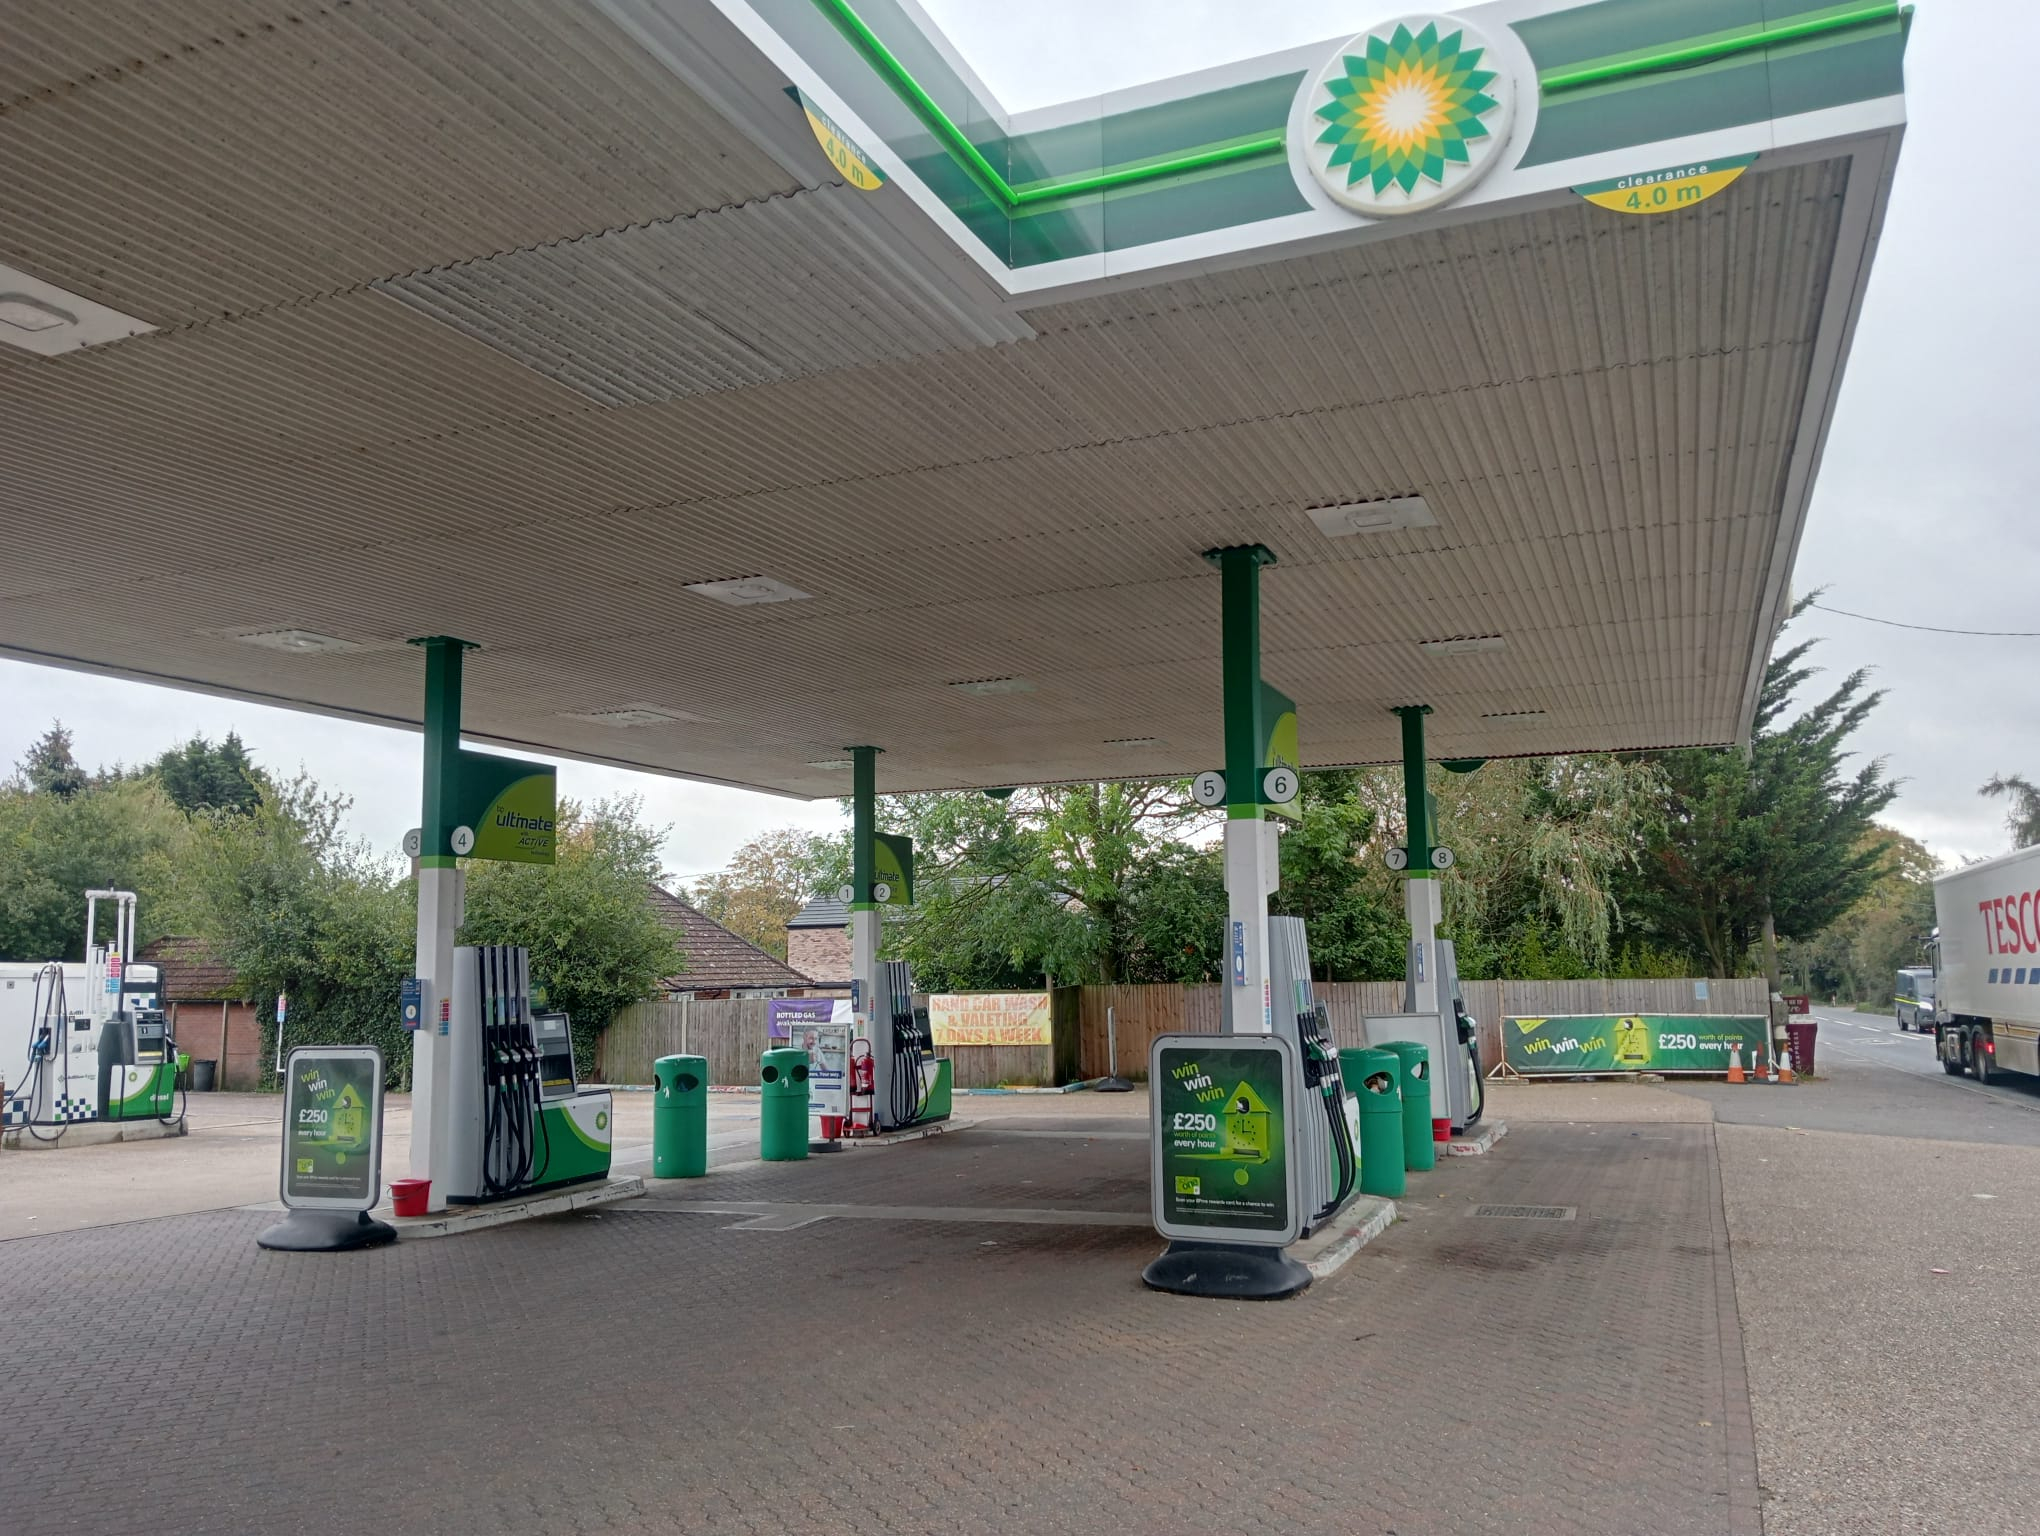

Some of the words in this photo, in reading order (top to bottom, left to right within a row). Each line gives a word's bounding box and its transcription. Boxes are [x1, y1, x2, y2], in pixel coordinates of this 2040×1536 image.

[822, 116, 867, 165] clearance
[826, 138, 847, 169] 4.0
[852, 164, 864, 187] m
[1617, 164, 1709, 189] clearance
[1625, 186, 1668, 210] 4.0
[1676, 183, 1702, 202] m
[1203, 780, 1215, 797] 5
[1275, 776, 1287, 794] 6
[496, 811, 553, 832] ultimate
[410, 835, 418, 850] 3
[458, 833, 467, 847] 4
[518, 837, 550, 847] ACTIVE
[1392, 853, 1400, 864] 7
[1438, 852, 1447, 863] 8
[879, 888, 885, 898] 2
[973, 997, 1000, 1011] CAR
[1005, 996, 1048, 1010] WASH
[960, 1012, 1028, 1027] VALETING
[947, 1028, 984, 1042] DAYS
[987, 1028, 996, 1042] A
[1000, 1027, 1042, 1042] WEEK
[1659, 1033, 1696, 1050] £250
[1524, 1037, 1551, 1055] win
[1551, 1037, 1579, 1054] win
[1579, 1036, 1606, 1053] win
[1699, 1043, 1722, 1051] every
[301, 1069, 320, 1083] win
[1171, 1062, 1199, 1079] win
[308, 1078, 328, 1092] win
[1183, 1074, 1212, 1091] win
[316, 1087, 336, 1101] win
[1196, 1086, 1225, 1103] win
[298, 1108, 328, 1123] £250
[1173, 1112, 1216, 1131] £250
[298, 1130, 312, 1138] every
[313, 1129, 326, 1137] hour
[1174, 1140, 1195, 1149] every
[1197, 1139, 1216, 1148] hour
